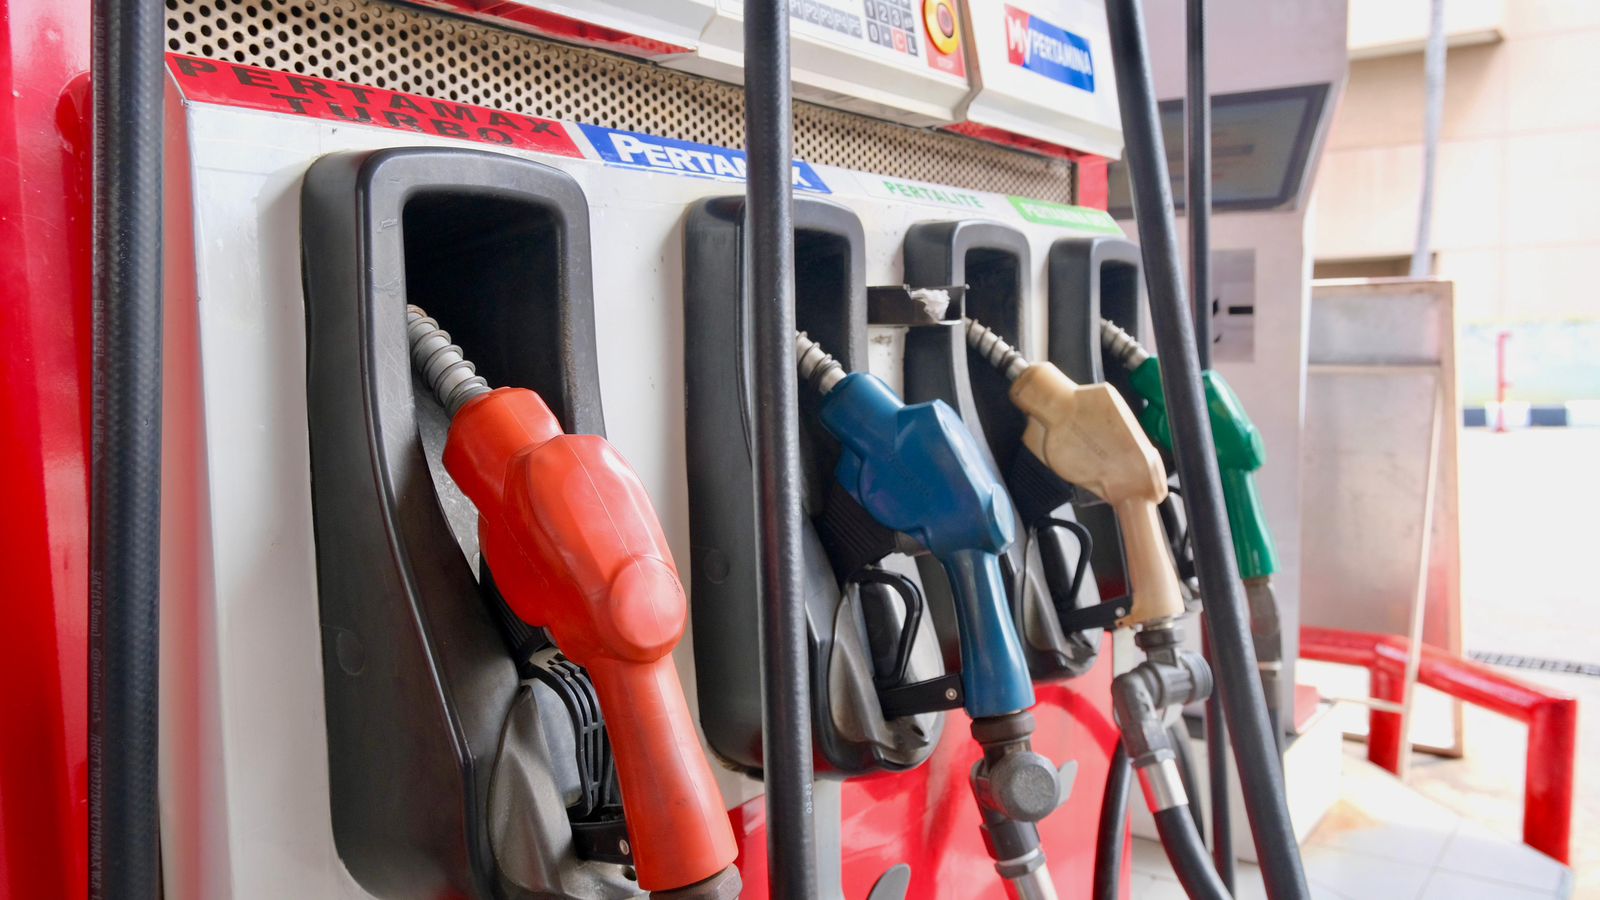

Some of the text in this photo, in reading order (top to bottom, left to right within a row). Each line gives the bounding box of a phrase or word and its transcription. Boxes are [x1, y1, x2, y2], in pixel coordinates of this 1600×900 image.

[866, 1, 874, 17] 1
[879, 5, 887, 22] 2
[892, 9, 901, 26] 3
[870, 24, 878, 41] 0
[176, 56, 561, 139] PERTAMAX
[271, 92, 514, 147] TURBO
[882, 180, 985, 209] PERTALITE
